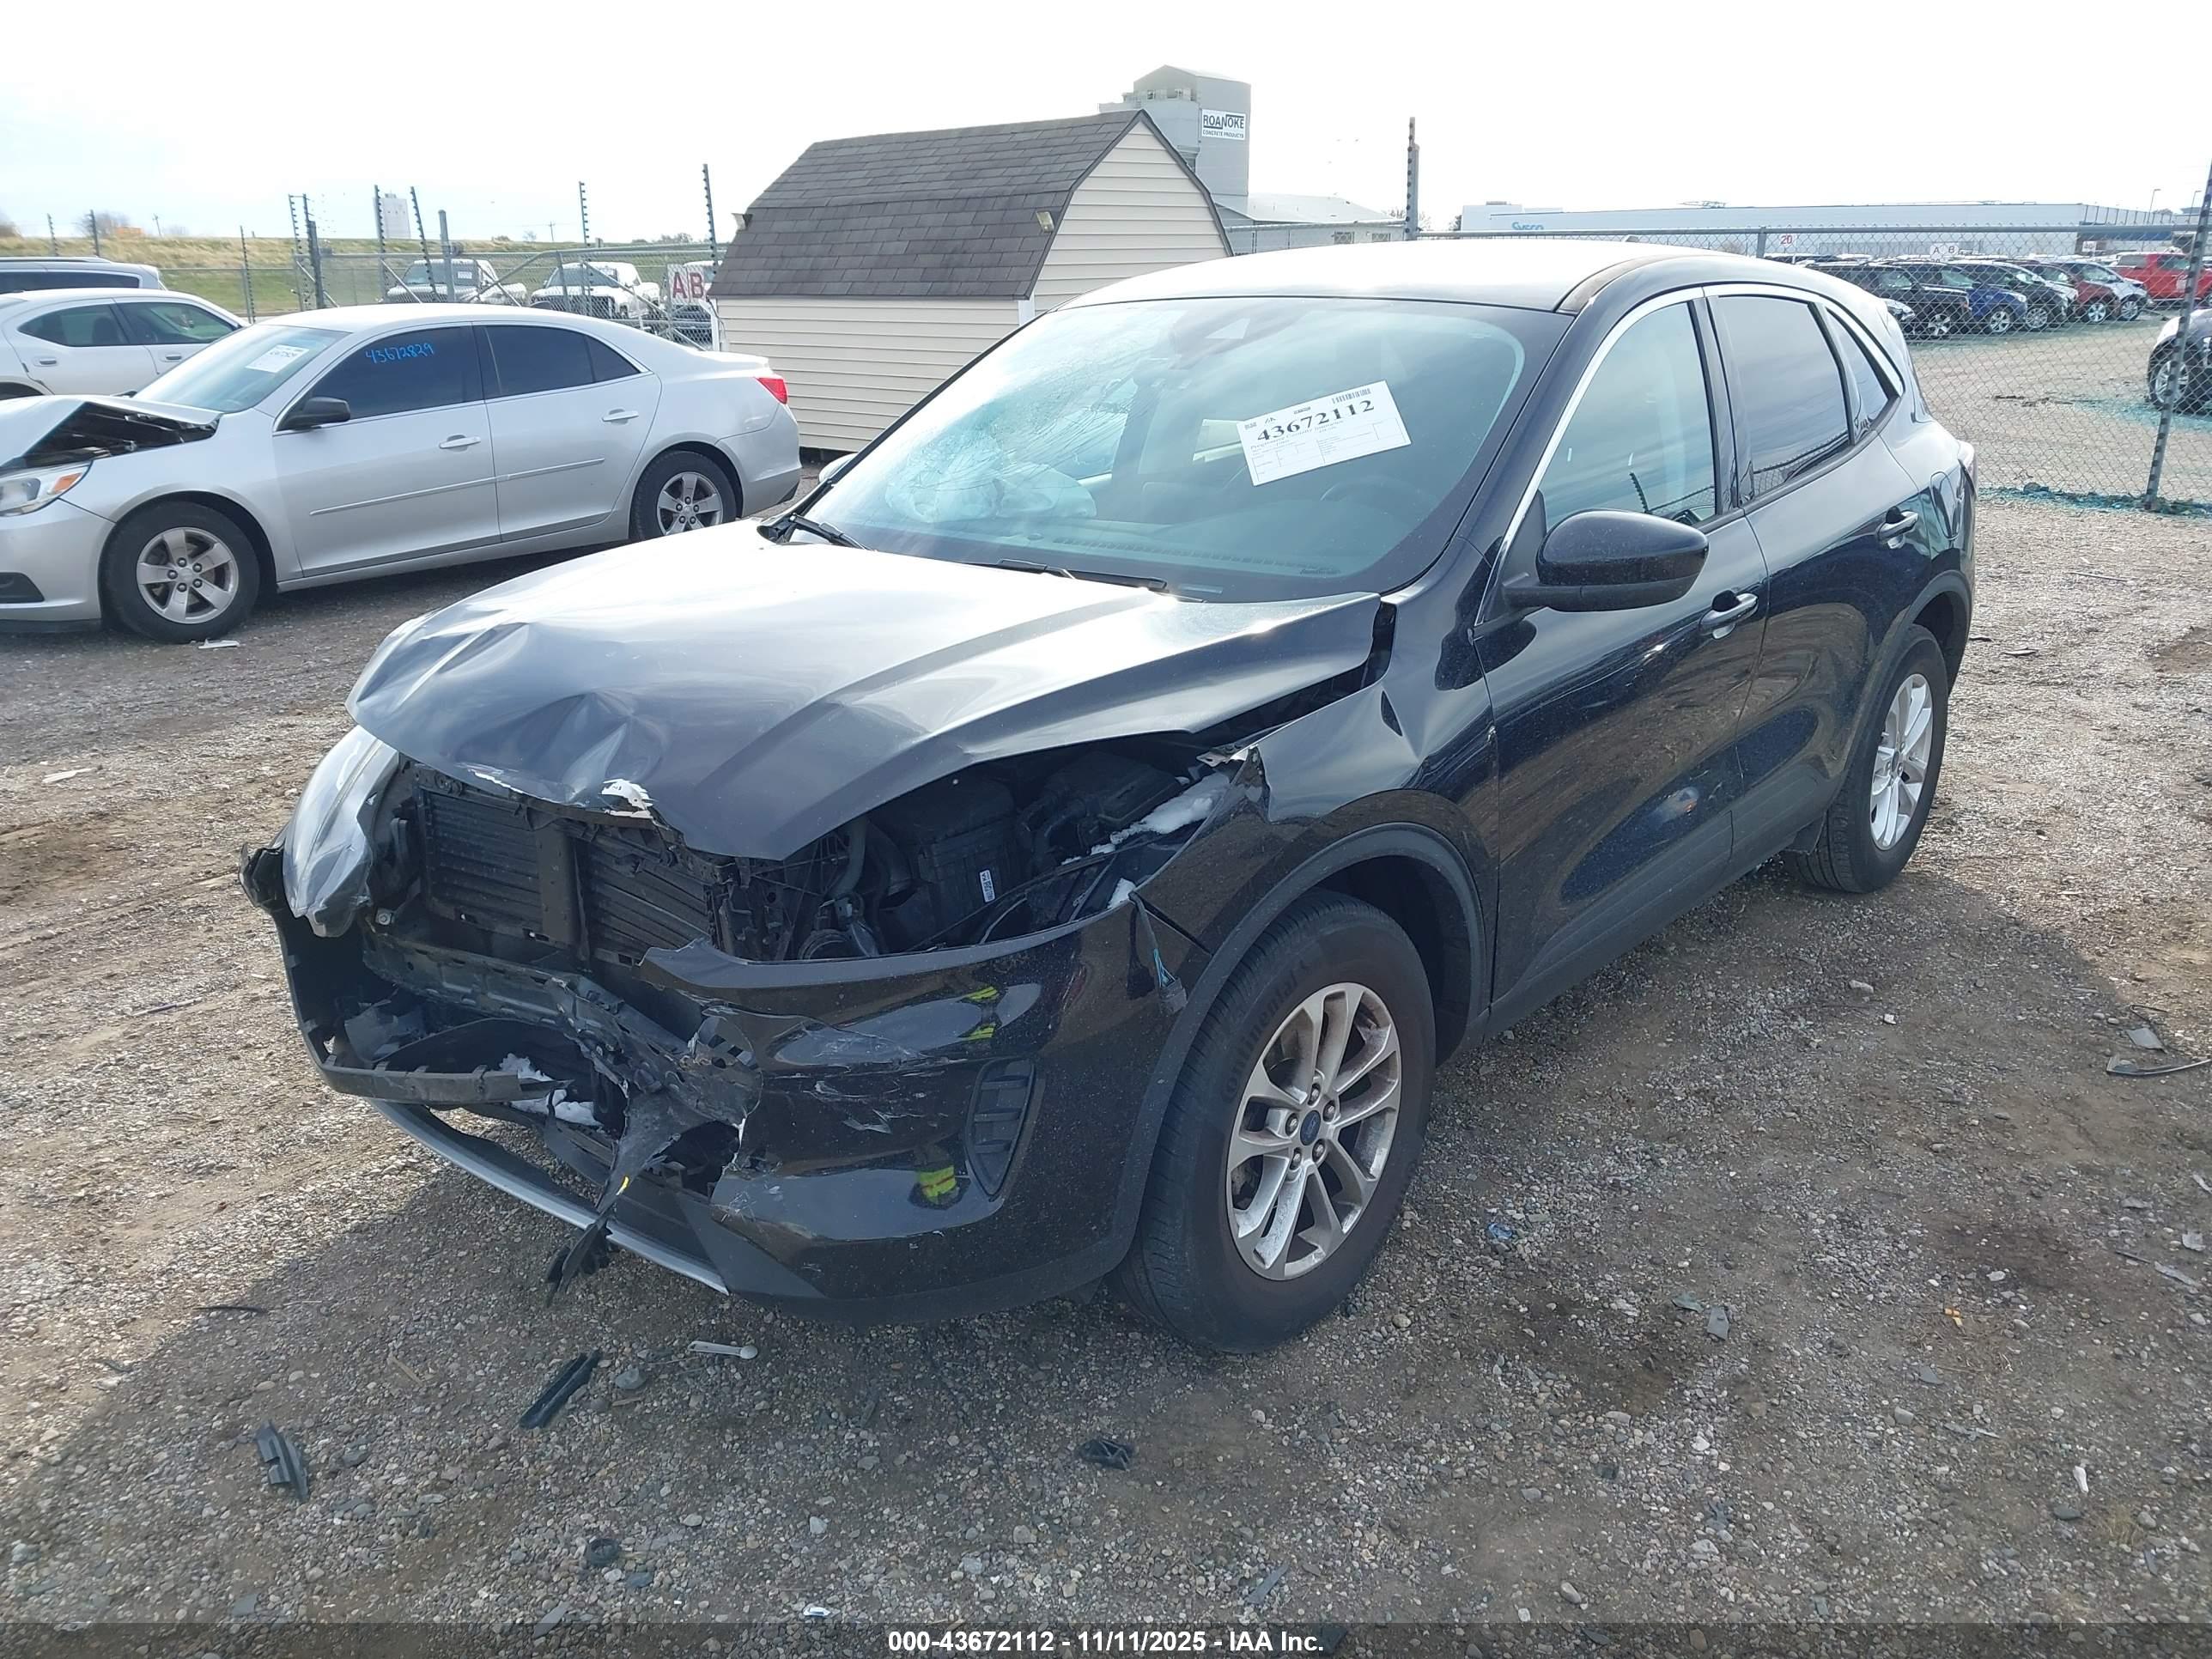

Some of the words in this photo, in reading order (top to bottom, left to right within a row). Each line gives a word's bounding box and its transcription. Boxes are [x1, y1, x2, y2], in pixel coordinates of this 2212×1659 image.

[1203, 114, 1244, 129] ROANOKE
[1781, 234, 1793, 244] 20
[365, 343, 434, 364] 43672829
[1257, 399, 1375, 441] 43672112
